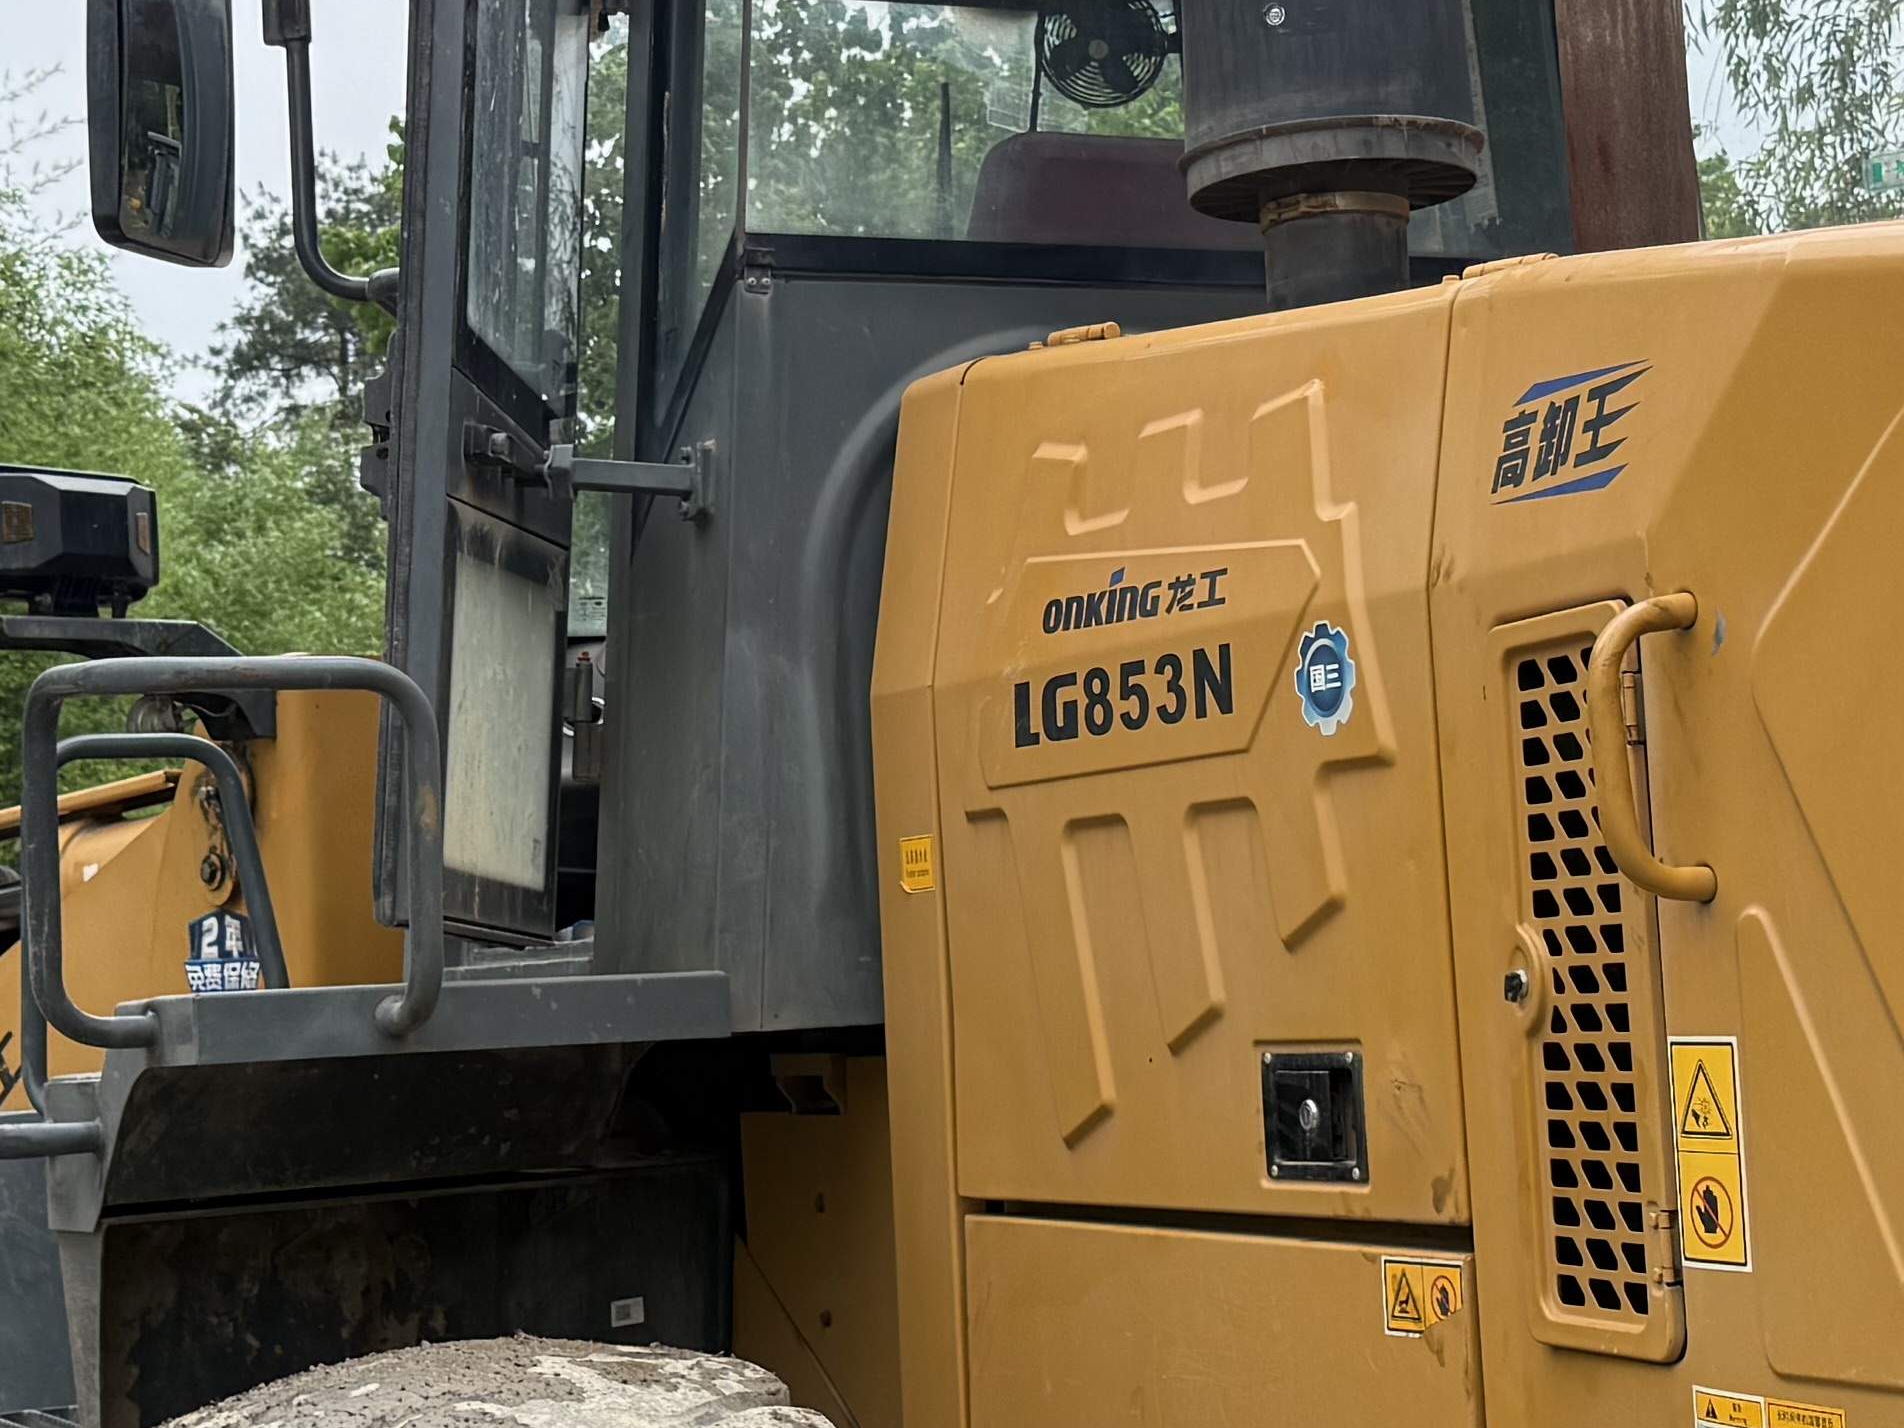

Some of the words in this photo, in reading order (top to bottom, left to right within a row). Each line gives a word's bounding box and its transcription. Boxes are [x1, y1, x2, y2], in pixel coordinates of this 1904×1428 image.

[1491, 365, 1653, 494] 高卸王
[1165, 568, 1228, 615] 龙工
[1015, 643, 1233, 749] LG853N
[1309, 664, 1341, 693] 国三
[201, 914, 244, 960] 2年
[185, 961, 260, 991] 免费保修
